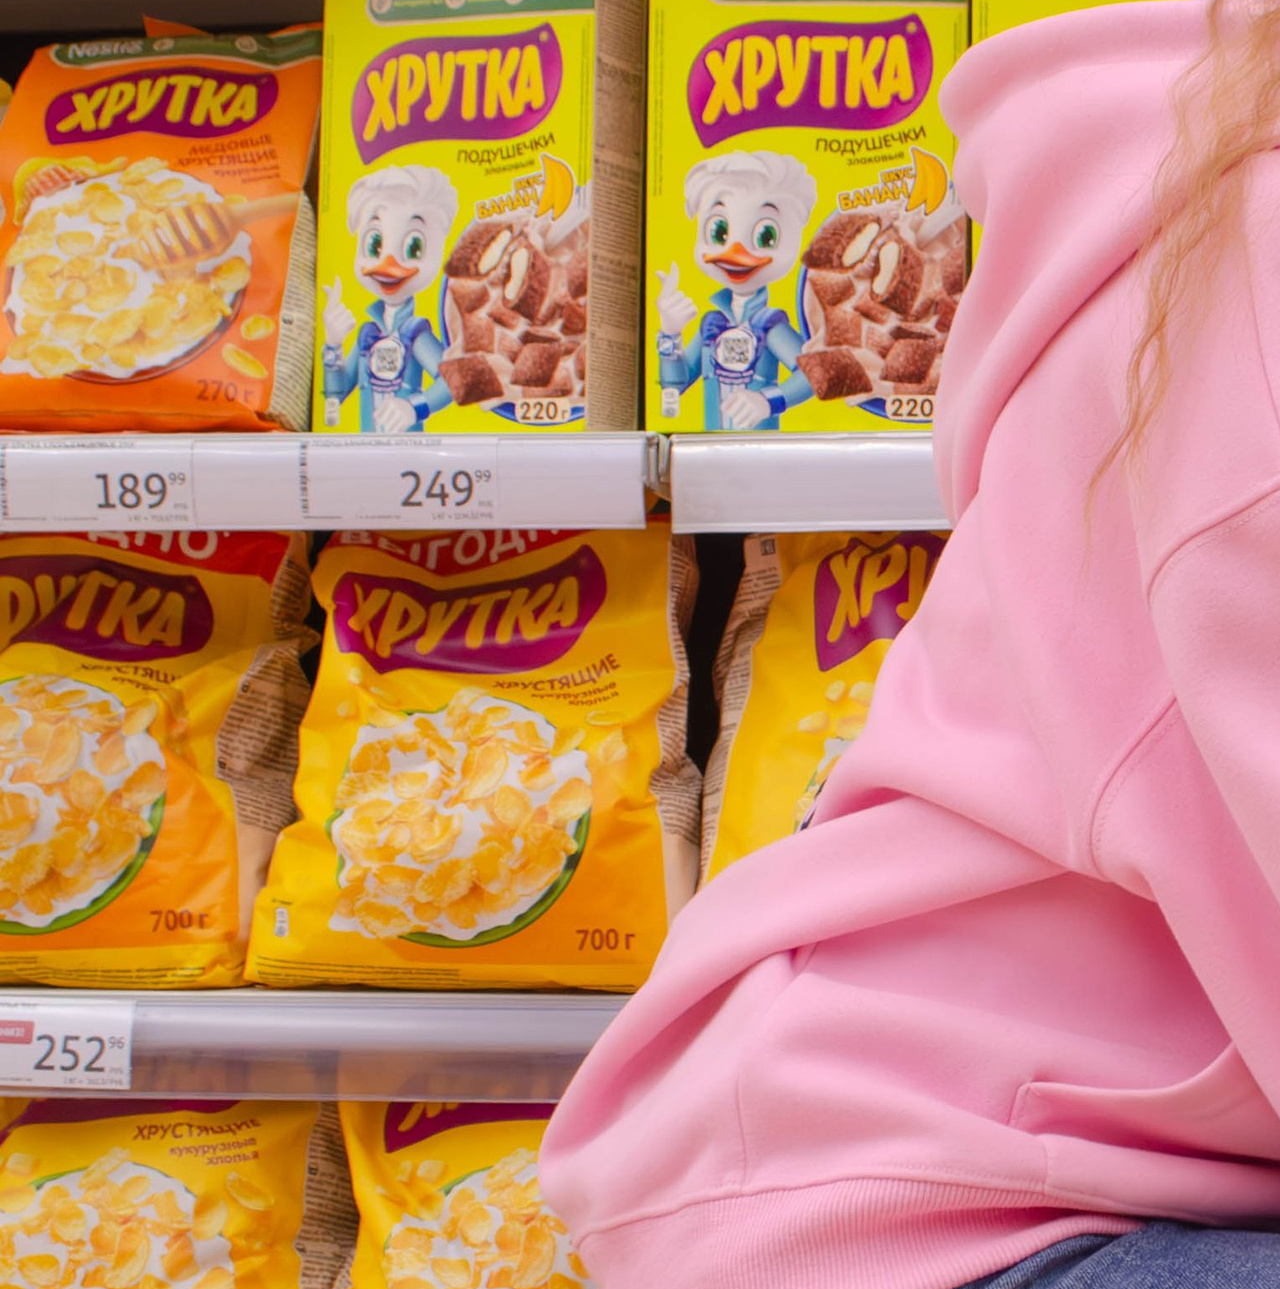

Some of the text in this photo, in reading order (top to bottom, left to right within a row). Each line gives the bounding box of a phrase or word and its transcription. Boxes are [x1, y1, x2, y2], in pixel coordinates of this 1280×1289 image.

[363, 48, 547, 141] ХРУТКА
[701, 36, 914, 125] ХРУТКА
[56, 74, 258, 132] ХРУТКА
[457, 132, 555, 165] ПОДУШЕЧКИ
[816, 126, 926, 156] ПОДУШЕЧКИ
[477, 188, 539, 219] БАНАН
[839, 181, 910, 211] БАНАН
[196, 380, 238, 402] 270
[520, 402, 557, 420] 220
[890, 397, 933, 419] 220
[96, 473, 186, 509] 189 99
[400, 470, 491, 507] 249 99
[348, 576, 579, 658] ХРУТКА
[493, 654, 620, 690] ХРУСТЯЩИЕ
[149, 911, 192, 933] 700
[576, 929, 620, 952] 700
[34, 1034, 125, 1072] 252 96
[133, 1118, 261, 1140] ХРУСТЯЩИЕ
[170, 1138, 257, 1156] кукурузные
[207, 1151, 259, 1166] хлопья
